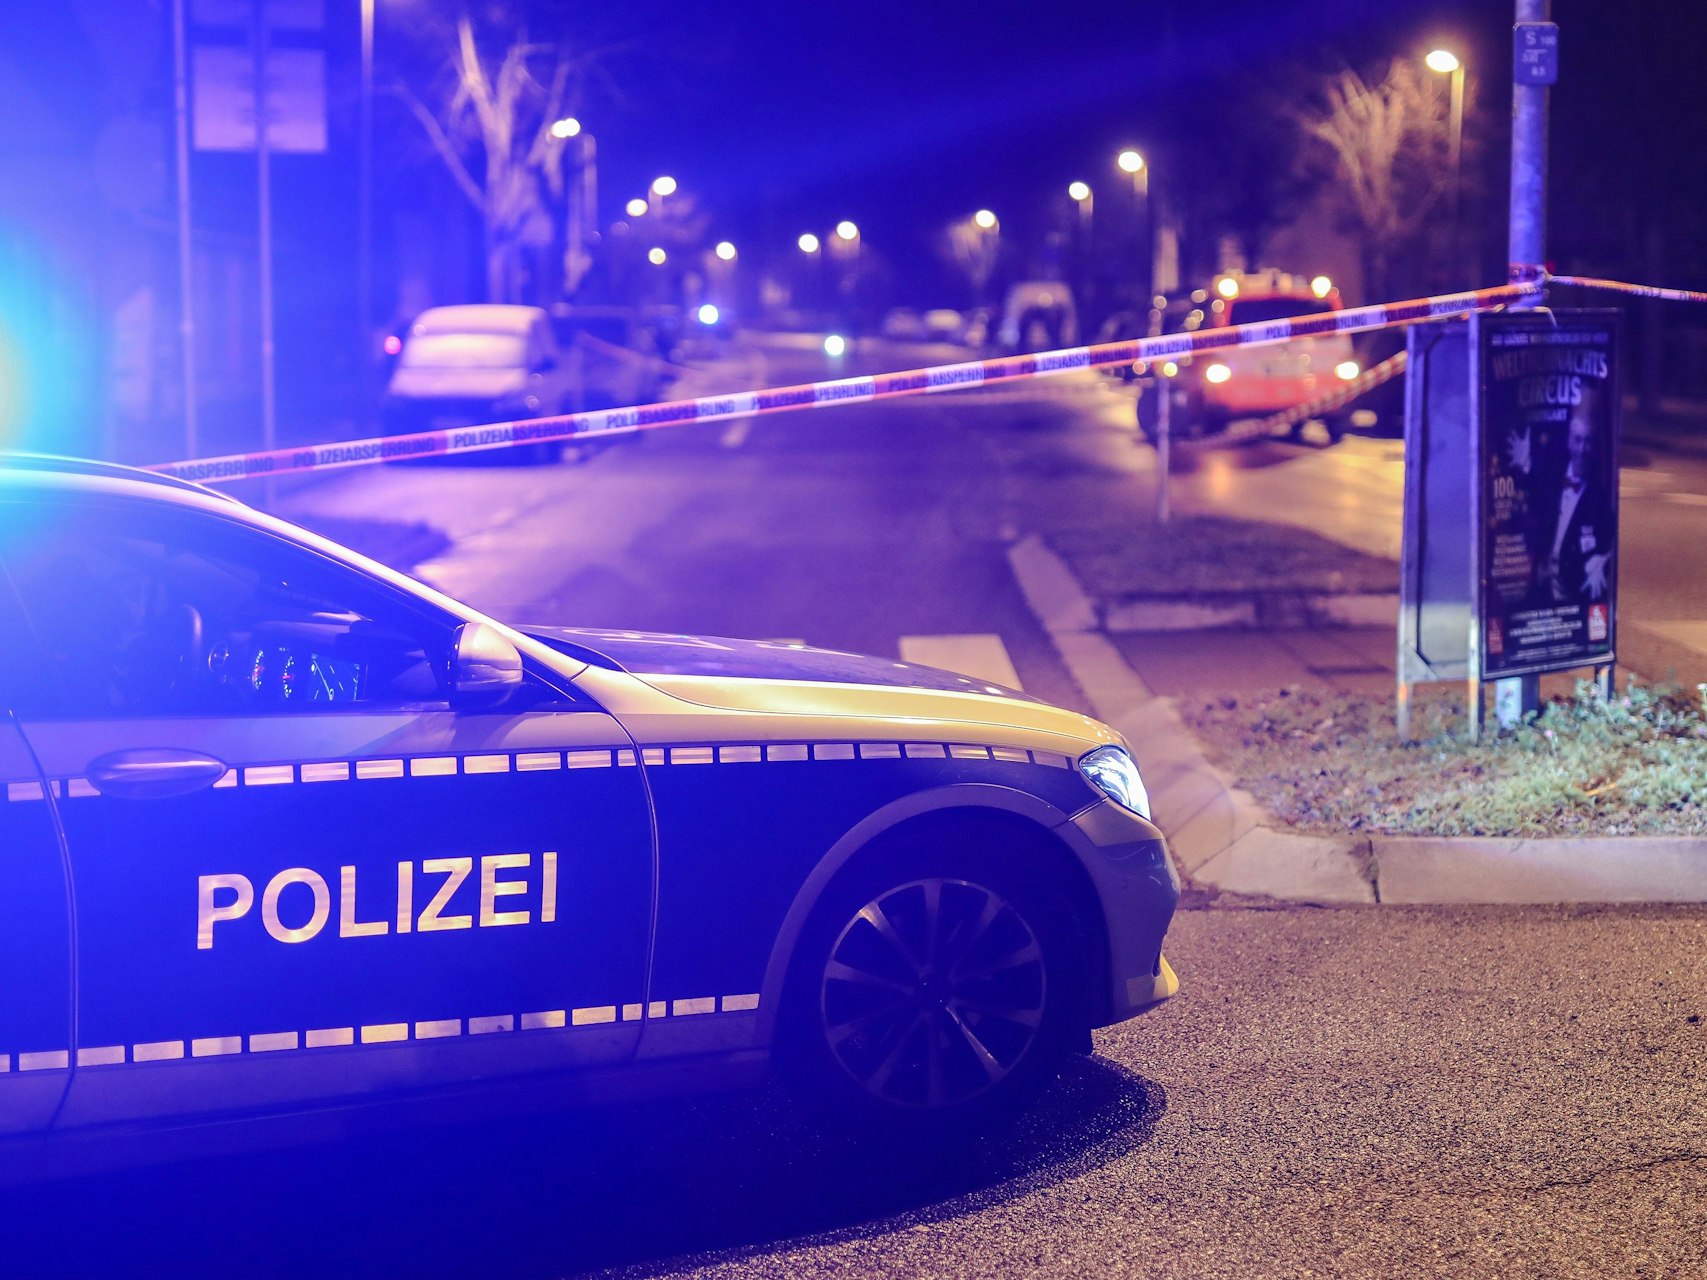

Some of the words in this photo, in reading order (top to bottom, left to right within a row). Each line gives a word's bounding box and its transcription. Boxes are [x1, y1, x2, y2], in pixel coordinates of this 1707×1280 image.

[1518, 375, 1582, 407] CIRCUS
[293, 436, 435, 468] POLIZEIABSPERRUNG
[454, 418, 589, 448] POLIZEIABSPERRUNG
[1494, 476, 1514, 498] 100
[197, 851, 558, 950] POLIZEI
